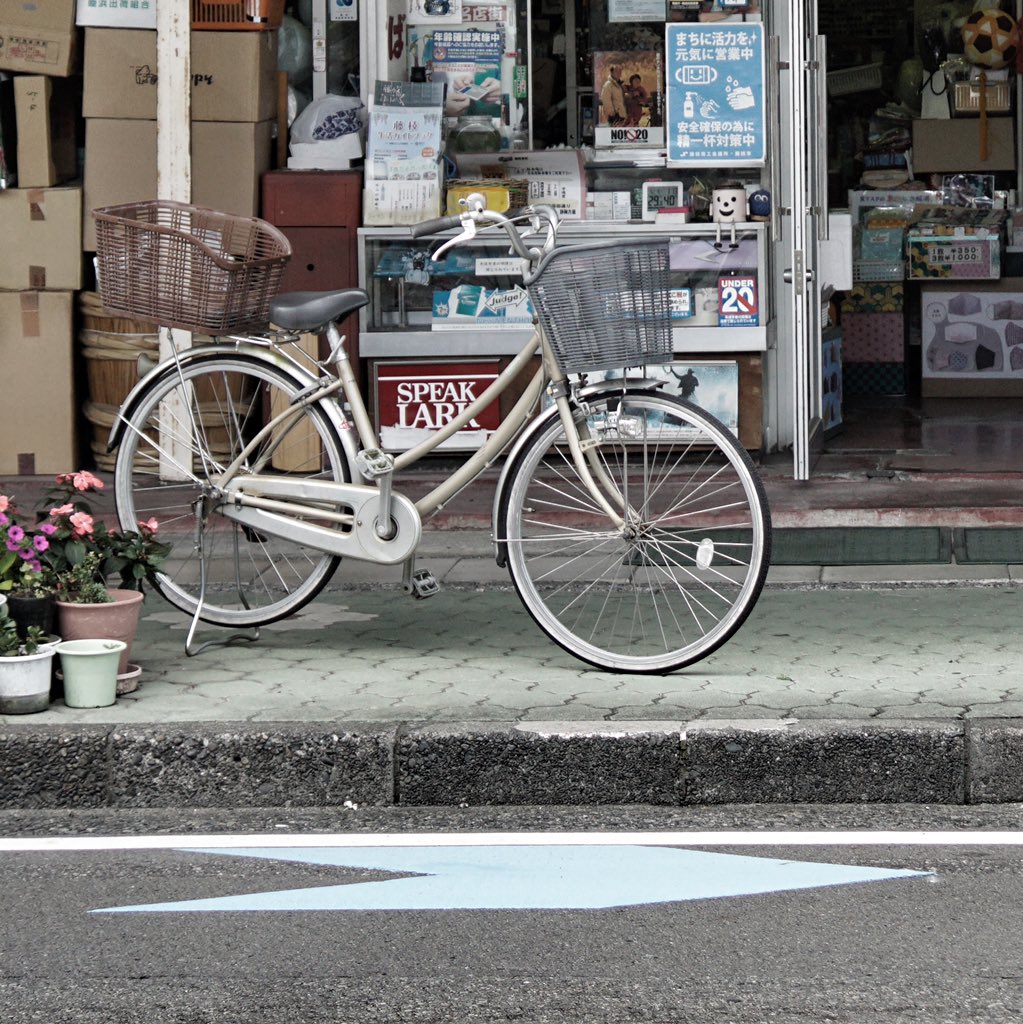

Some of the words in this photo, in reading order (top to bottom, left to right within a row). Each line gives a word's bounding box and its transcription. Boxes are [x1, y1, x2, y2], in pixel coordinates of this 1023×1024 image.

[434, 32, 500, 42] 年齢確認実施中
[675, 48, 753, 61] 元気に営業中
[677, 121, 754, 133] 安全確保の為に
[677, 134, 755, 148] 精一杯対策中
[721, 279, 754, 287] UNDER
[490, 291, 522, 307] Judge!
[721, 287, 755, 313] 20
[397, 381, 478, 404] SPEAK
